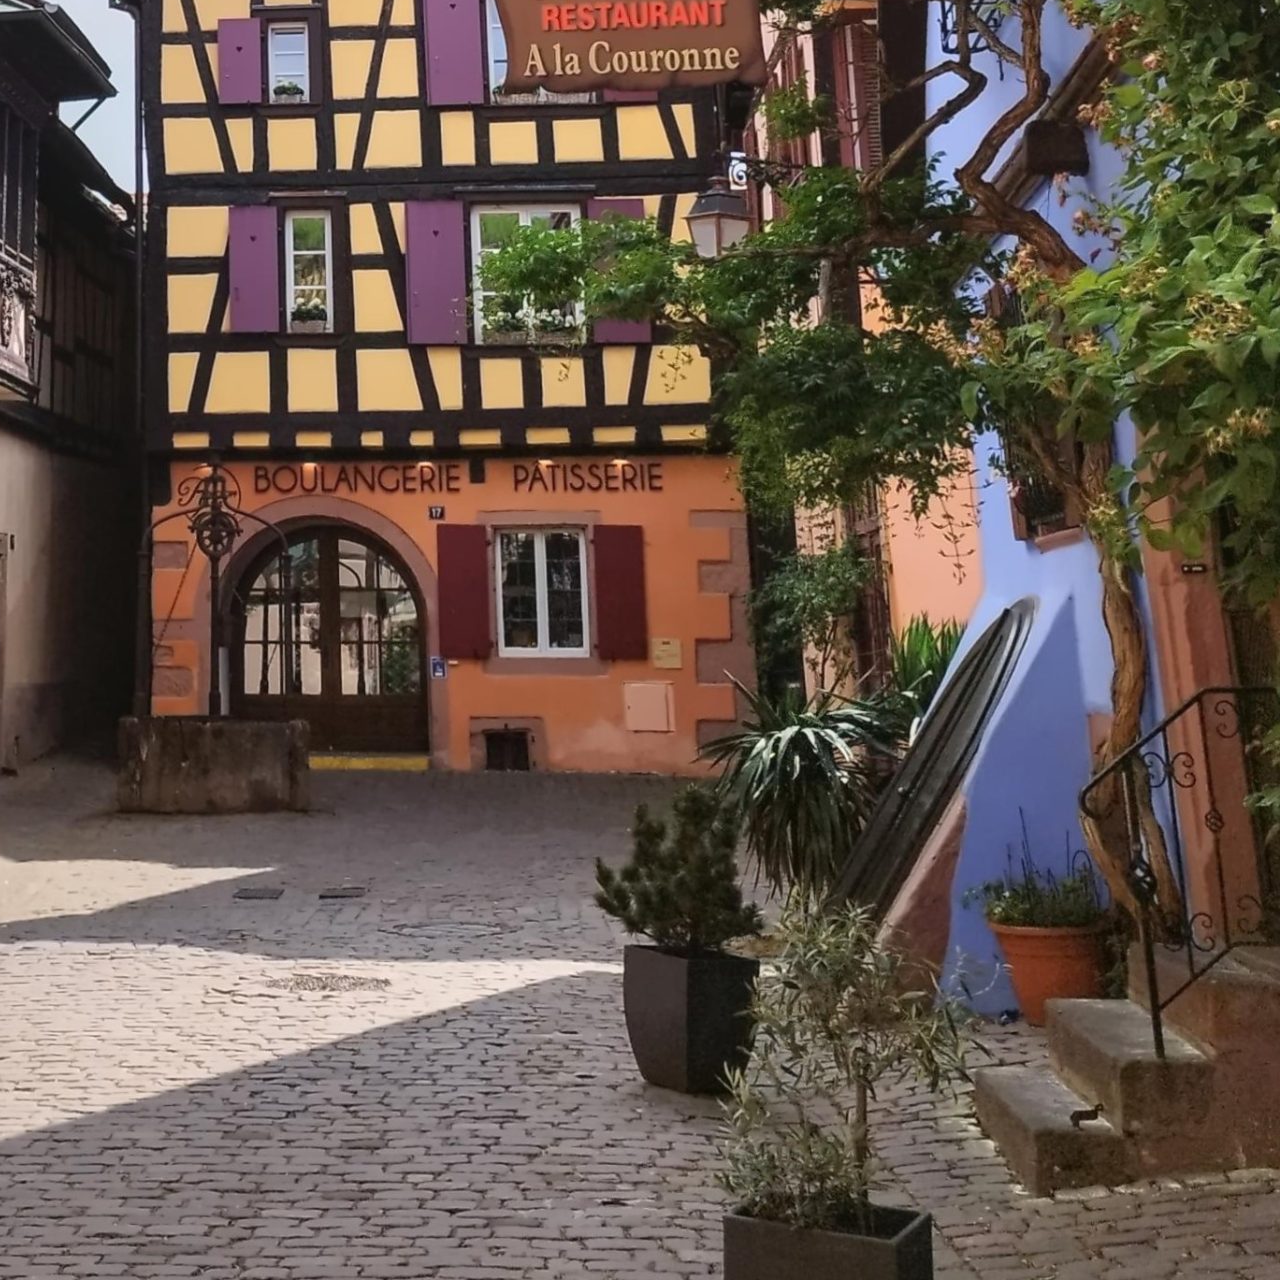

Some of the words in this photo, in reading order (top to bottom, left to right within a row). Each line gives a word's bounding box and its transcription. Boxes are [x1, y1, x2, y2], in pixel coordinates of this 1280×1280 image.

[541, 0, 727, 32] RESTAURANT
[523, 43, 548, 77] A
[552, 41, 581, 76] la
[588, 40, 740, 75] Couronne
[253, 464, 461, 494] BOULANGERIE
[512, 460, 664, 492] PÂTISSERIE
[431, 507, 442, 519] 17
